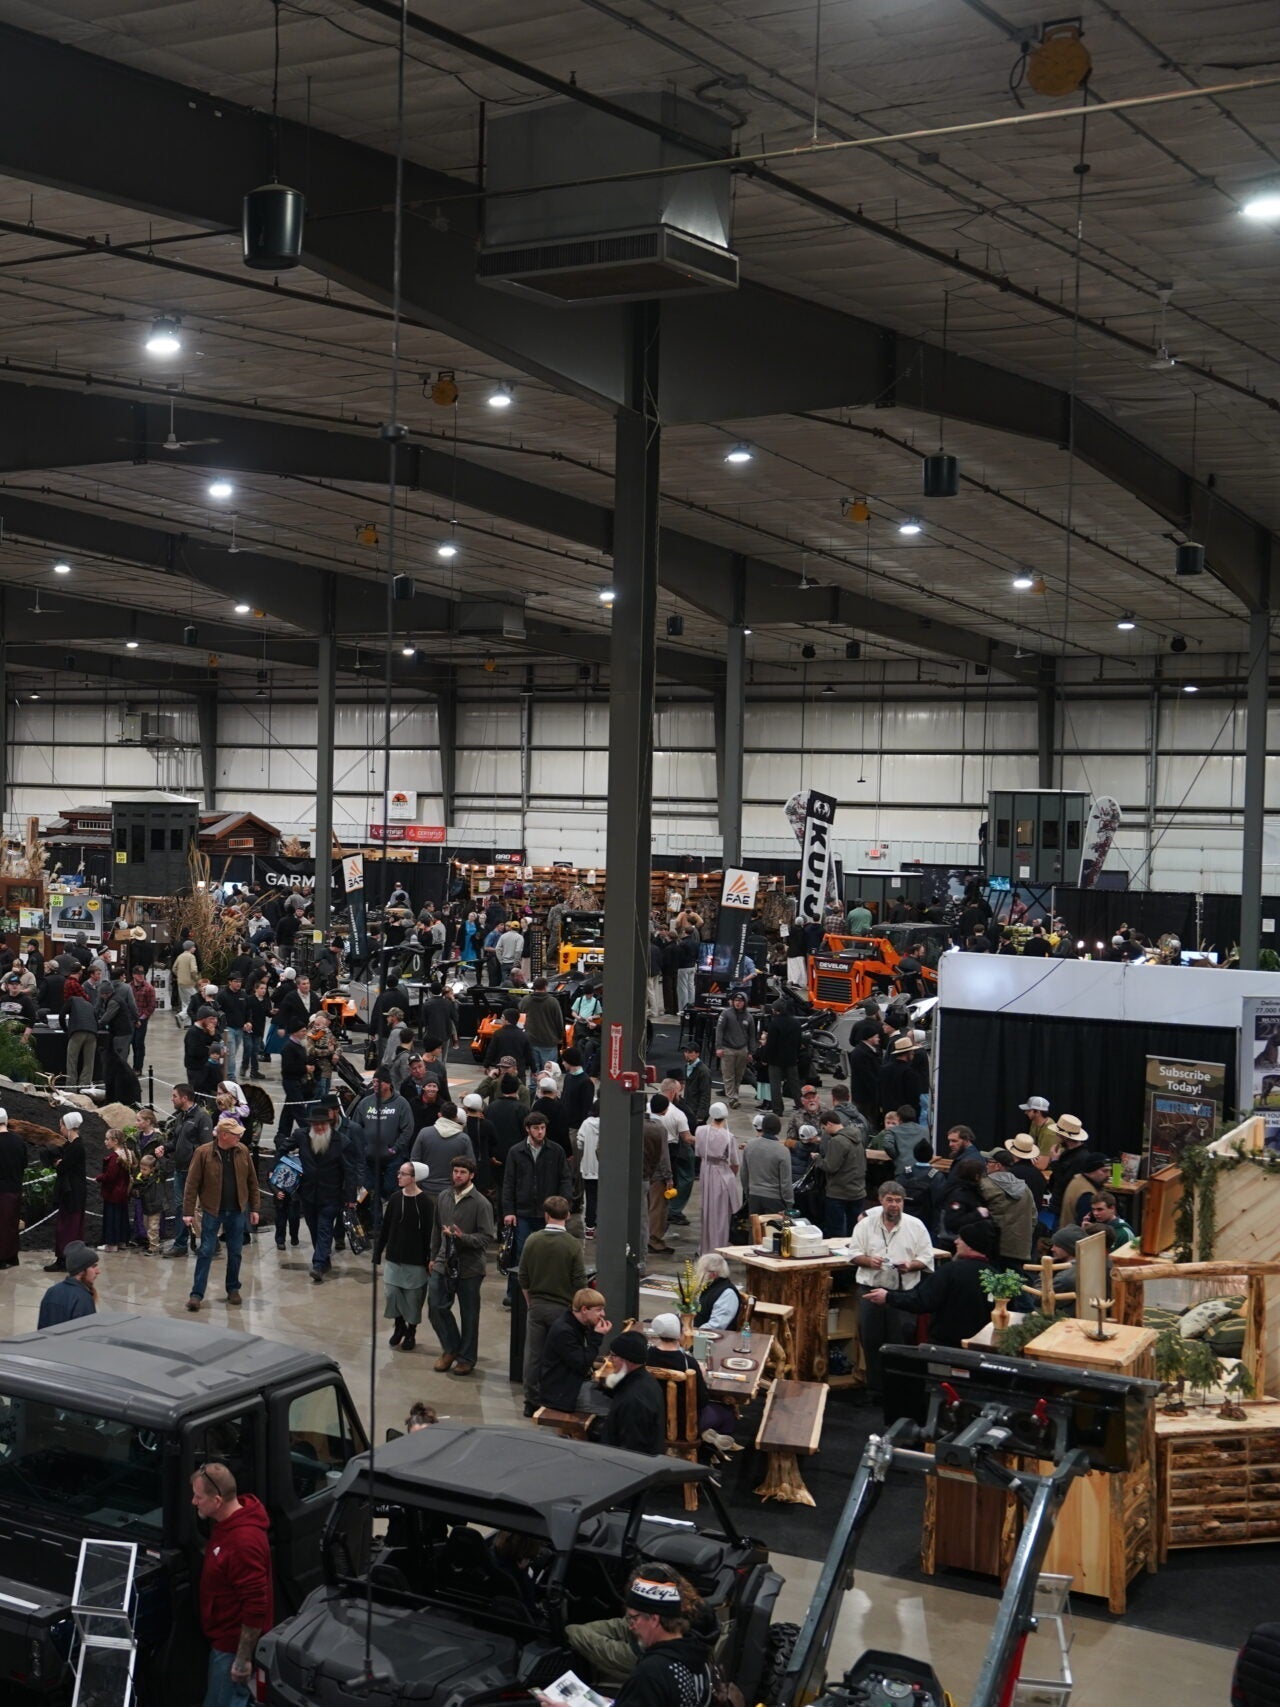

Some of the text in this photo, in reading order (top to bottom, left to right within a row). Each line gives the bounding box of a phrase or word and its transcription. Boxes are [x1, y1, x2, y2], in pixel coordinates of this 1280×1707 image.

[726, 894, 750, 905] FAE
[1159, 1066, 1211, 1081] Subscribe
[1167, 1080, 1202, 1094] Today!
